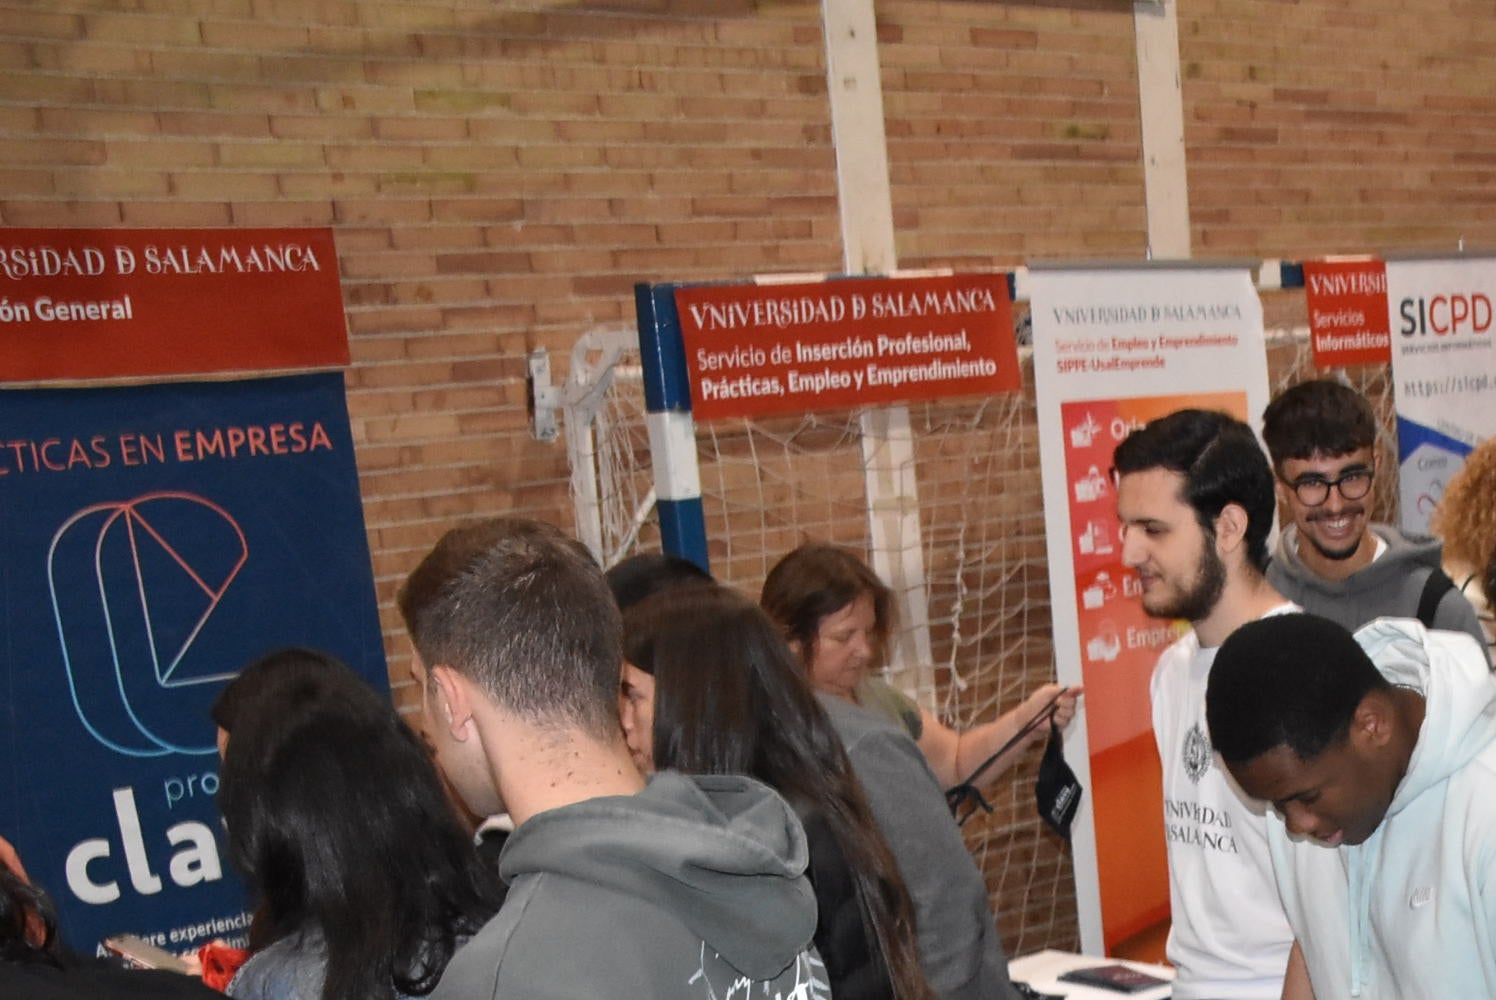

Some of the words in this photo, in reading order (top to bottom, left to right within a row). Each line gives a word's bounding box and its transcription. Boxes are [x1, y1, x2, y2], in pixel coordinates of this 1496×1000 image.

[145, 244, 320, 274] SALAMANCA
[35, 294, 133, 322] General
[872, 288, 996, 319] SALAMANCA
[1313, 308, 1365, 329] Servicios
[1400, 294, 1493, 336] SICPD
[697, 341, 766, 371] Servicio
[771, 342, 792, 365] de
[796, 335, 874, 364] Inserción
[877, 329, 971, 357] Profesional,
[1111, 335, 1149, 352] Empleo
[1159, 333, 1238, 350] Emprendimiento
[1316, 330, 1389, 352] Informáticos
[701, 371, 784, 401] Prácticas,
[788, 366, 850, 395] Empleo
[853, 370, 865, 391] y
[866, 356, 996, 388] Emprendimiento
[0, 437, 111, 475] TICAS
[120, 432, 165, 466] EN
[174, 421, 333, 462] EMPRESA
[65, 786, 226, 905] cla
